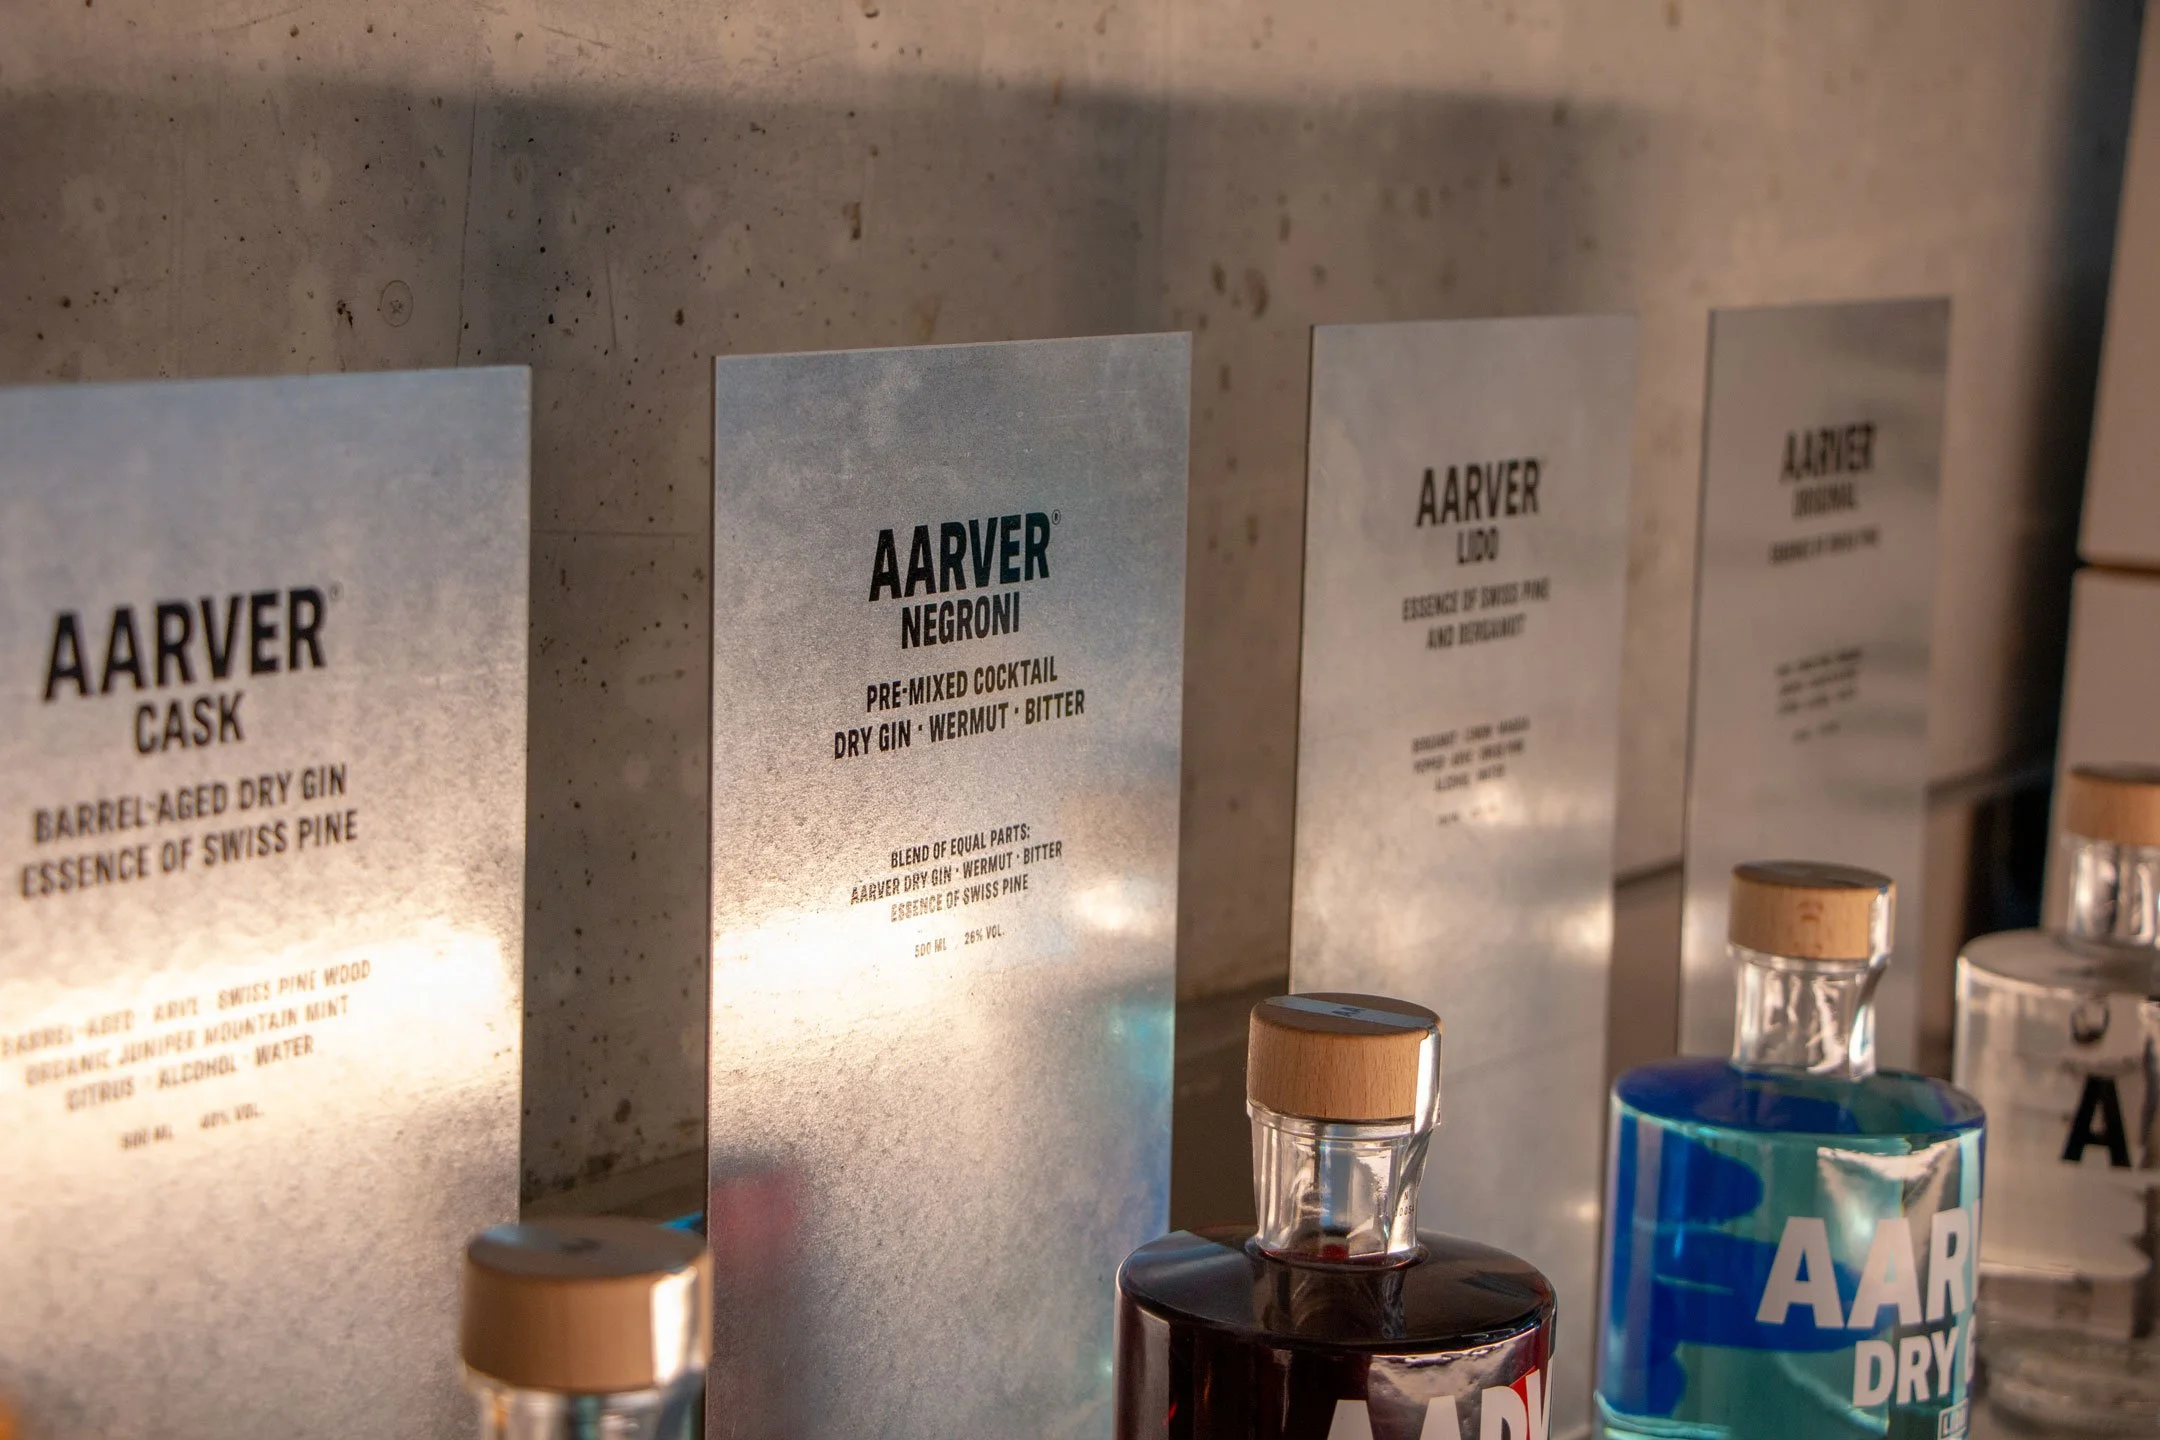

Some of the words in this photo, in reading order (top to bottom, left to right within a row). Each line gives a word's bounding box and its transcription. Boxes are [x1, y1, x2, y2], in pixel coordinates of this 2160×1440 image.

[1415, 456, 1539, 528] AARVER
[1457, 526, 1499, 565] LIDO
[902, 591, 1020, 649] NEGRONI
[866, 670, 968, 713] PRE-MIXED
[974, 656, 1058, 695] COCKTAIL
[135, 692, 245, 754] CASK
[834, 726, 872, 760] DRY
[879, 720, 911, 752] GIN
[929, 702, 1009, 743] WERMUT
[1025, 689, 1085, 725] BITTER
[35, 784, 227, 843] BARREL-AGED
[240, 773, 293, 810] DRY
[303, 763, 347, 798] GIN
[21, 848, 150, 898] ESSENCE
[162, 837, 194, 872] OF
[205, 822, 288, 866] SWISS
[300, 810, 358, 850] PINE
[851, 878, 900, 905] AARVER
[904, 872, 927, 892] DRY
[932, 866, 951, 886] GIN
[963, 853, 1012, 879] WERMUT
[1023, 841, 1062, 864] BITTER
[891, 844, 929, 868] BLEND
[934, 840, 947, 860] OF
[950, 832, 986, 856] EQUAL
[990, 823, 1031, 847] PARTS:
[891, 894, 942, 922] ESSENCE
[946, 889, 960, 909] OF
[963, 882, 999, 905] SWISS
[1002, 874, 1029, 895] PINE
[935, 938, 947, 953] ML
[964, 929, 983, 945] 26%
[218, 980, 270, 1010] SWISS
[279, 970, 316, 995] PINE
[324, 959, 370, 986] WOOD
[204, 1007, 298, 1046] MOUNTAIN
[305, 994, 348, 1022] MINT
[66, 1076, 134, 1112] CITRUS
[158, 1051, 238, 1090] ALCOHOL
[255, 1033, 314, 1067] WATER
[1853, 1327, 1960, 1409] DRY
